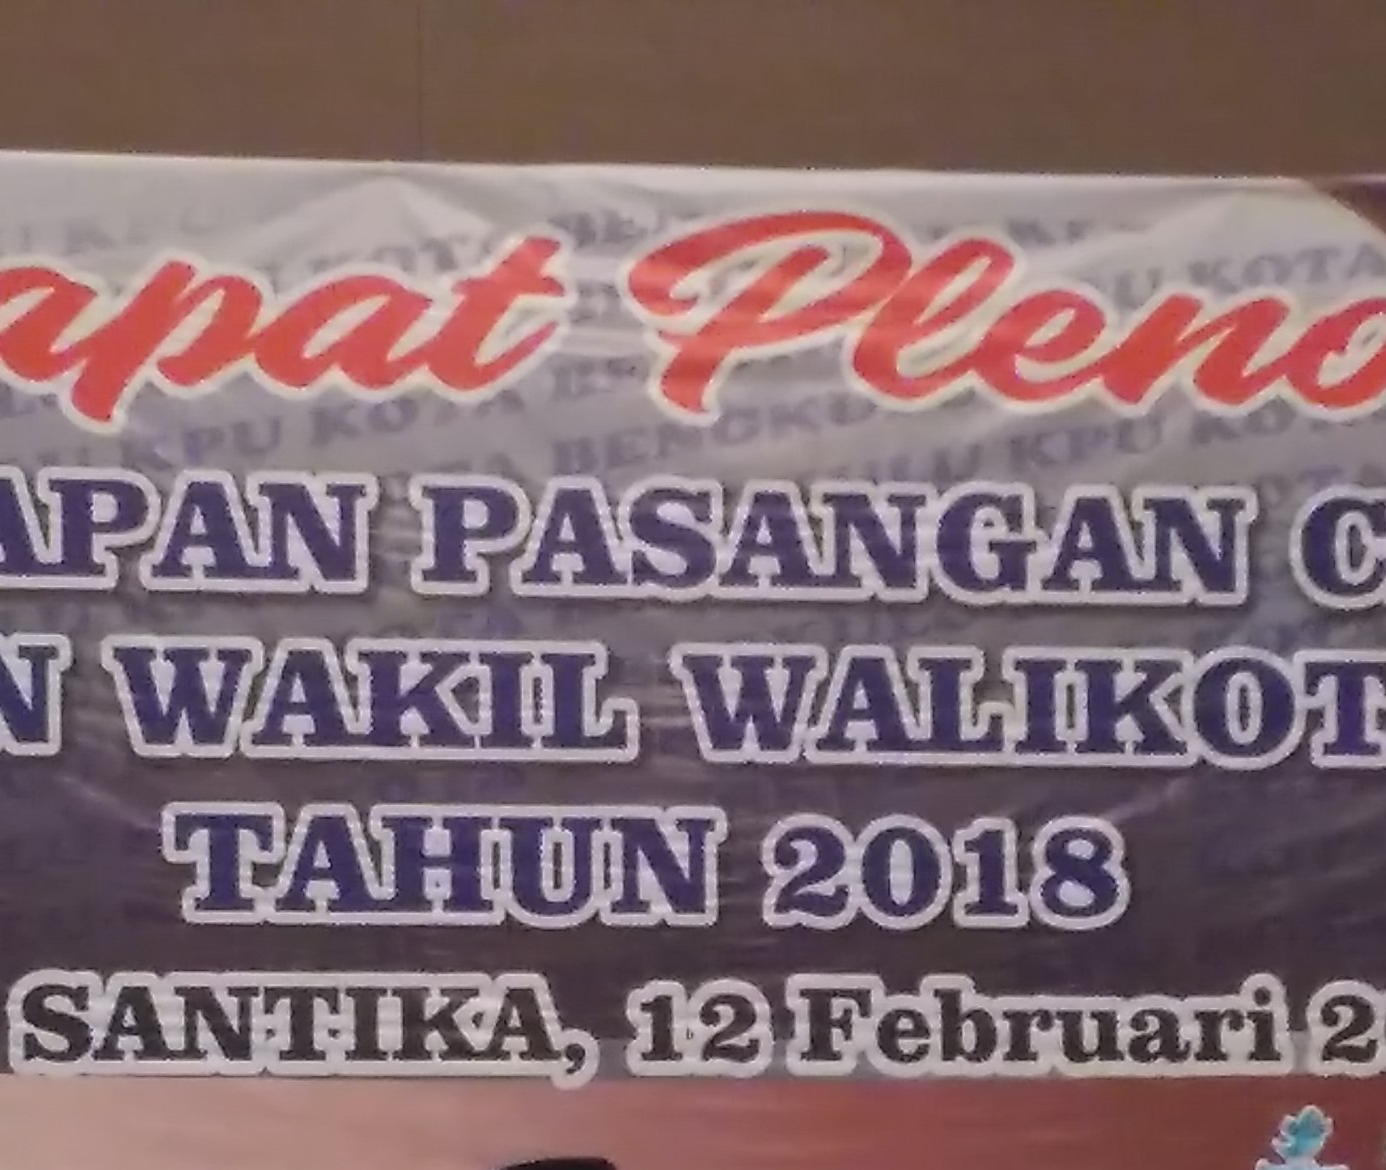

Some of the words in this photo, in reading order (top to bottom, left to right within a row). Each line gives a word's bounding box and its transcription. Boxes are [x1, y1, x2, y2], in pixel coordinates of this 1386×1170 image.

[420, 483, 1247, 592] PASANGAN
[112, 645, 630, 750] WAKIL
[173, 810, 718, 918] TAHUN
[770, 824, 1121, 918] 2018
[21, 981, 588, 1076] SANTIKA,
[638, 991, 762, 1064] 12
[798, 980, 1286, 1066] Februari
